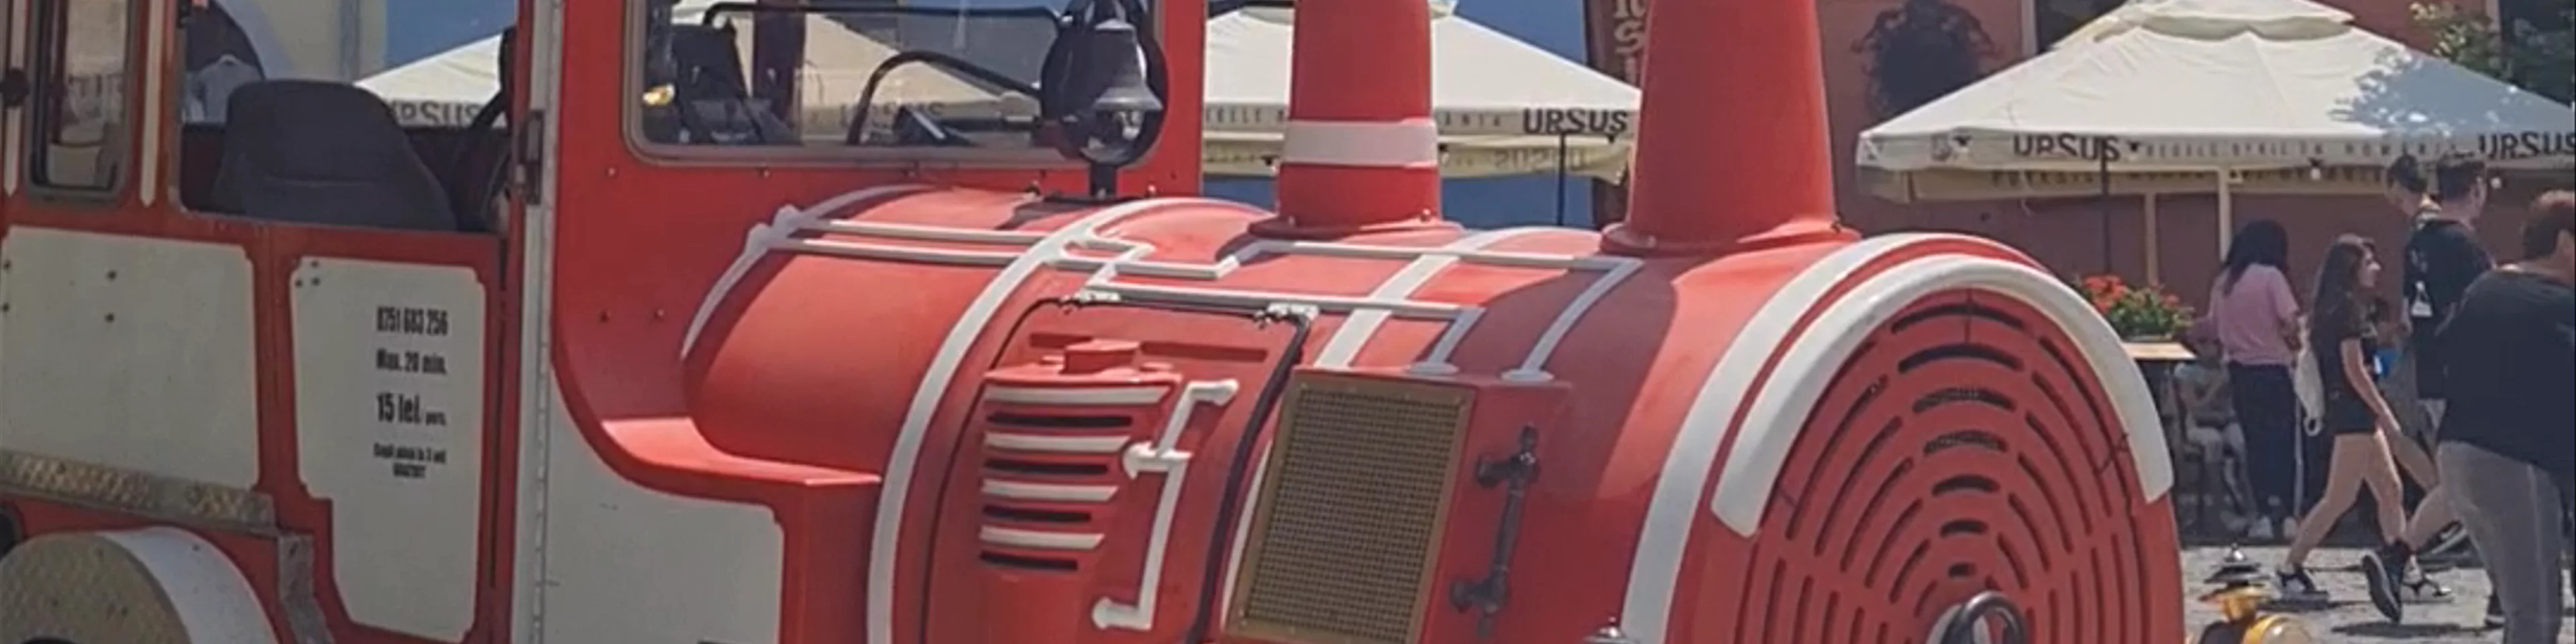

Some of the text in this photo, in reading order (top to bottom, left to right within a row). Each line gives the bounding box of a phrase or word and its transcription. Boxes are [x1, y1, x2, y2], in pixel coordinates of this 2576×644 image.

[1523, 107, 1629, 134] URSUS
[2013, 133, 2121, 162] URSUS
[376, 392, 394, 423] 15
